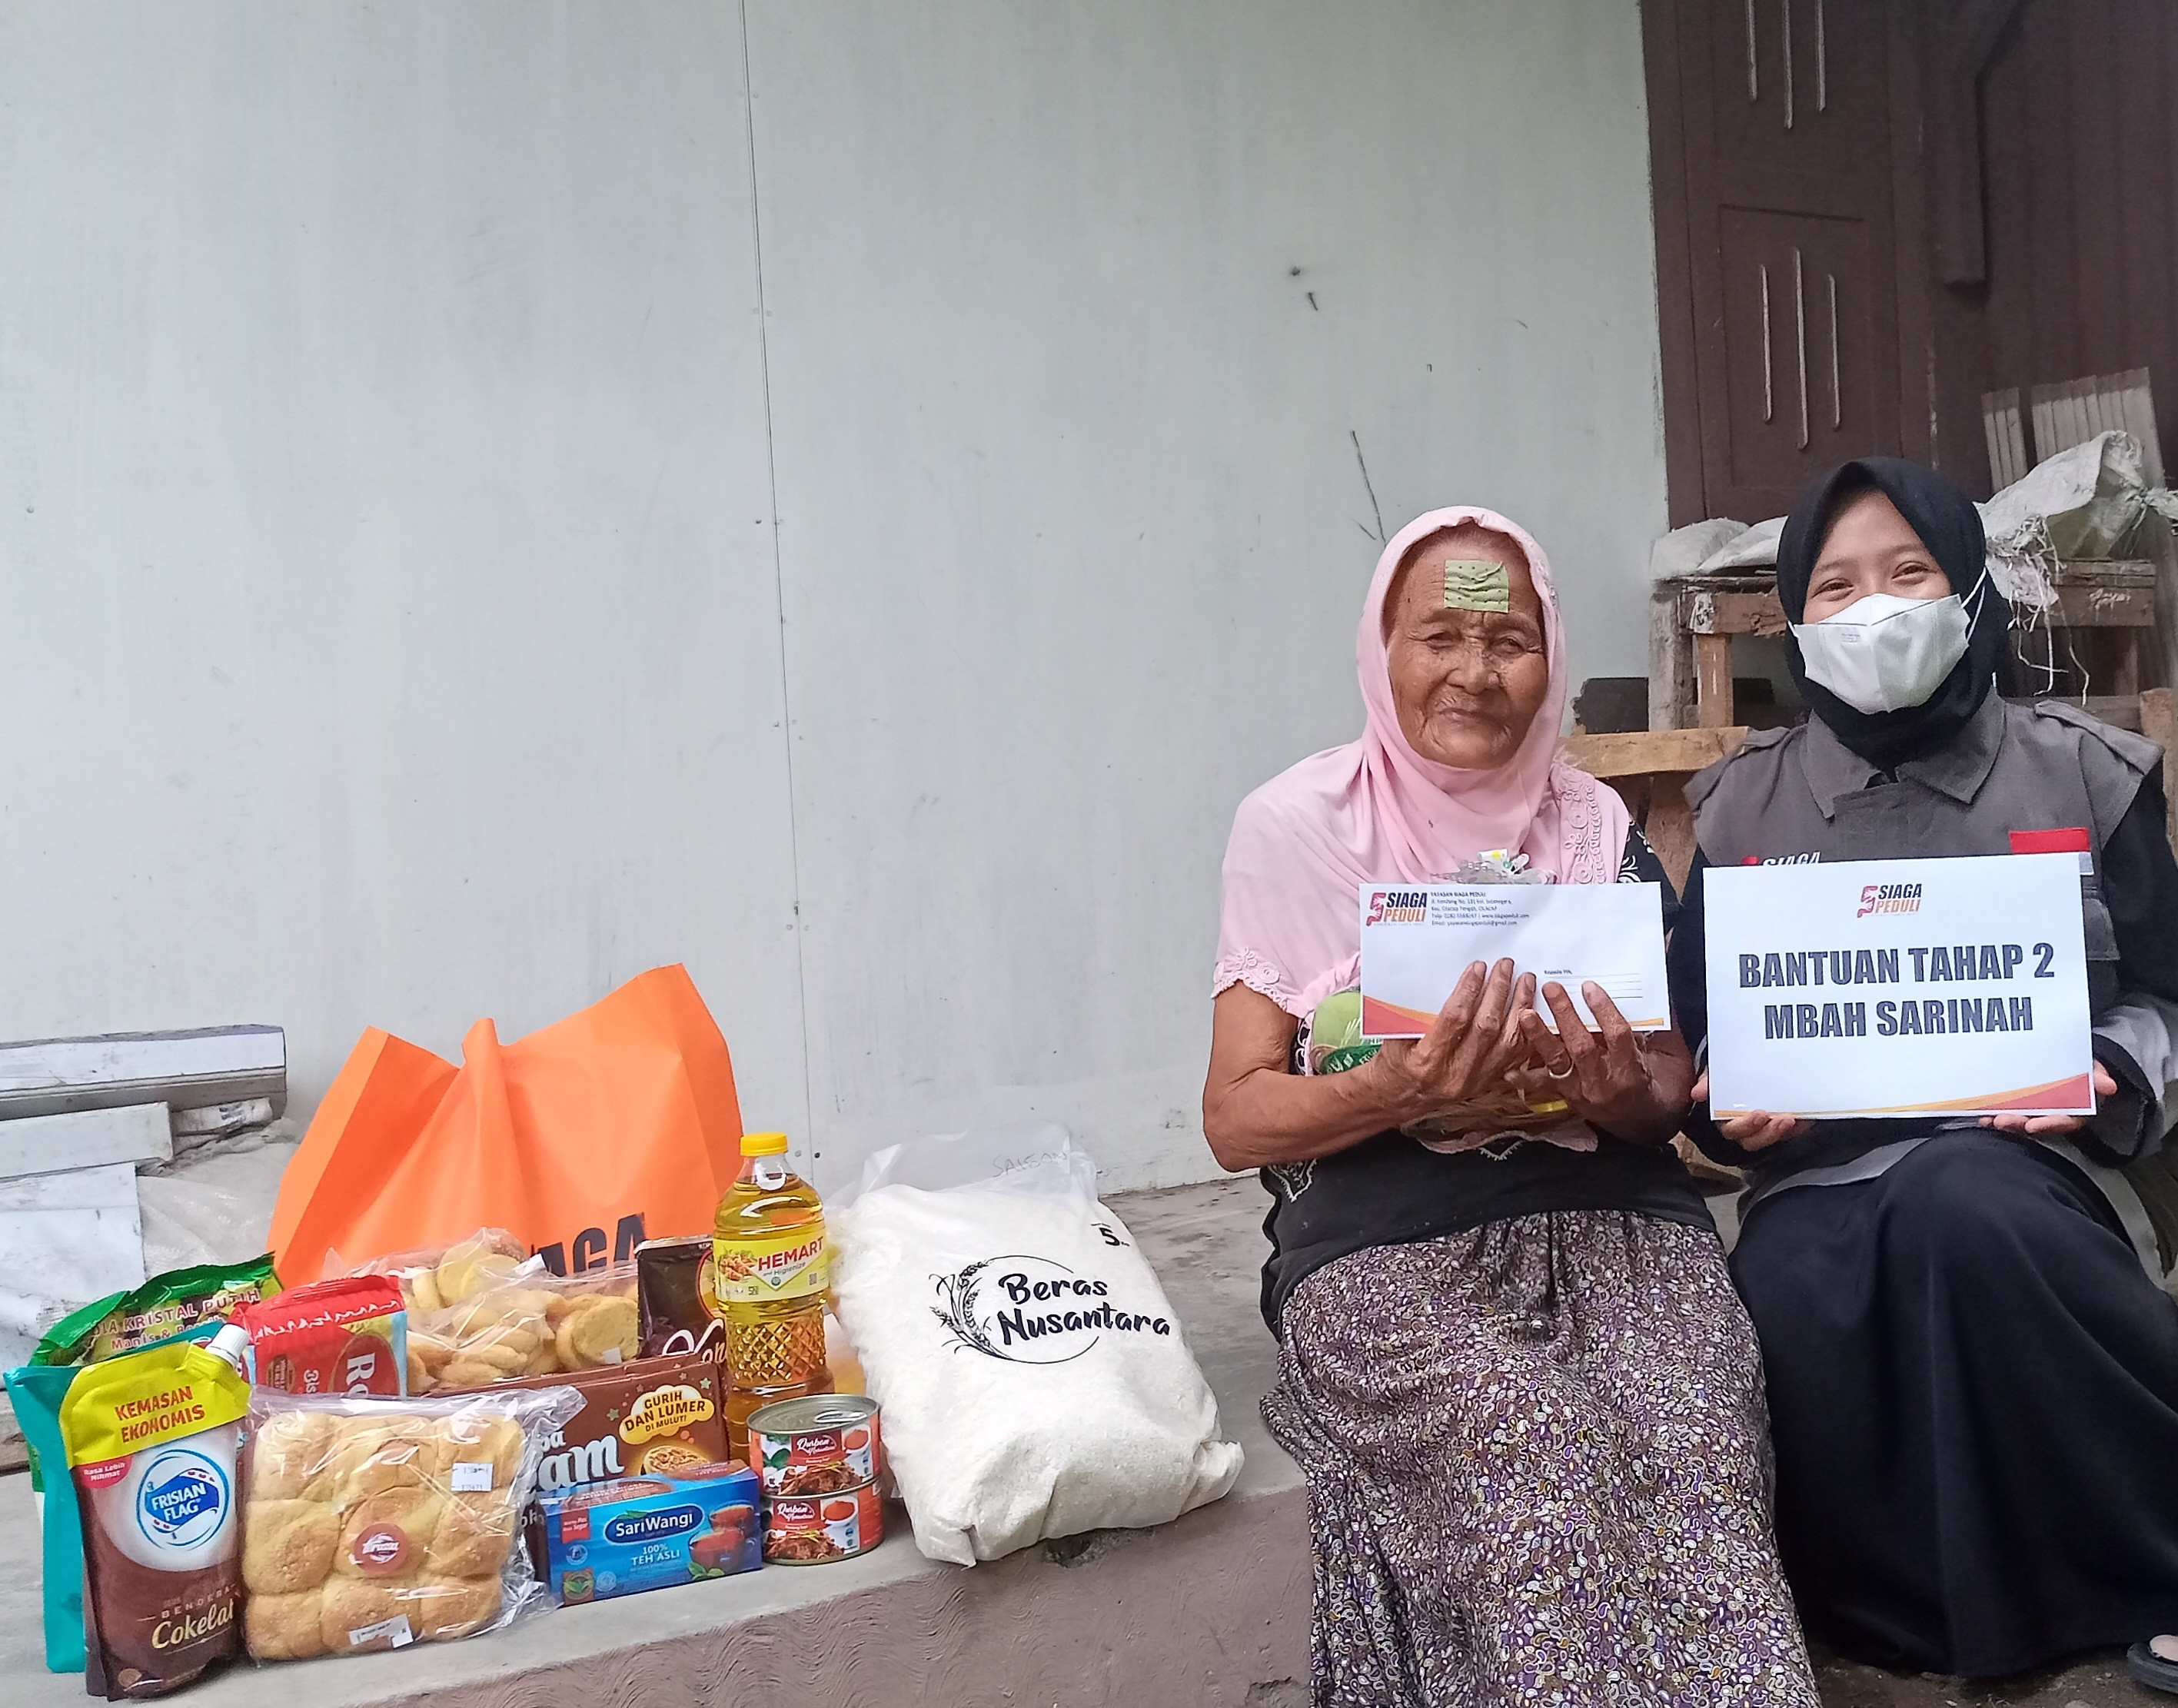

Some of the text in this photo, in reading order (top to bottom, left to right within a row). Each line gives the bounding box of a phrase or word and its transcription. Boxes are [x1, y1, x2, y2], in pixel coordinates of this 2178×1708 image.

[1386, 892, 1428, 908] SIAGA
[1878, 883, 1922, 899] SIAGA
[1384, 908, 1426, 922] PEDULI
[1875, 899, 1921, 913] PEDULI
[1738, 942, 2055, 989] BANTUAN TAHAP 2
[1764, 997, 2034, 1040] MBAH SARINAH
[530, 1212, 647, 1278] AGA
[1099, 1227, 1120, 1247] 5
[758, 1236, 823, 1271] HEMART
[998, 1273, 1108, 1305] Beras
[123, 1304, 198, 1333] KRISTAL
[203, 1288, 261, 1313] PUTIH
[997, 1301, 1171, 1346] Nusantara
[111, 1333, 155, 1350] Manis
[115, 1385, 193, 1421] KEMASAN
[644, 1391, 683, 1409] GURIH
[121, 1404, 205, 1444] EKONOMIS
[624, 1401, 706, 1431] DAN LUMER
[151, 1482, 207, 1511] FRISIAN
[163, 1500, 199, 1522] FLAG
[616, 1512, 693, 1537] SariWangi
[631, 1550, 680, 1566] TEH ASLI
[643, 1544, 668, 1555] 100%
[161, 1585, 230, 1619] BENDERA
